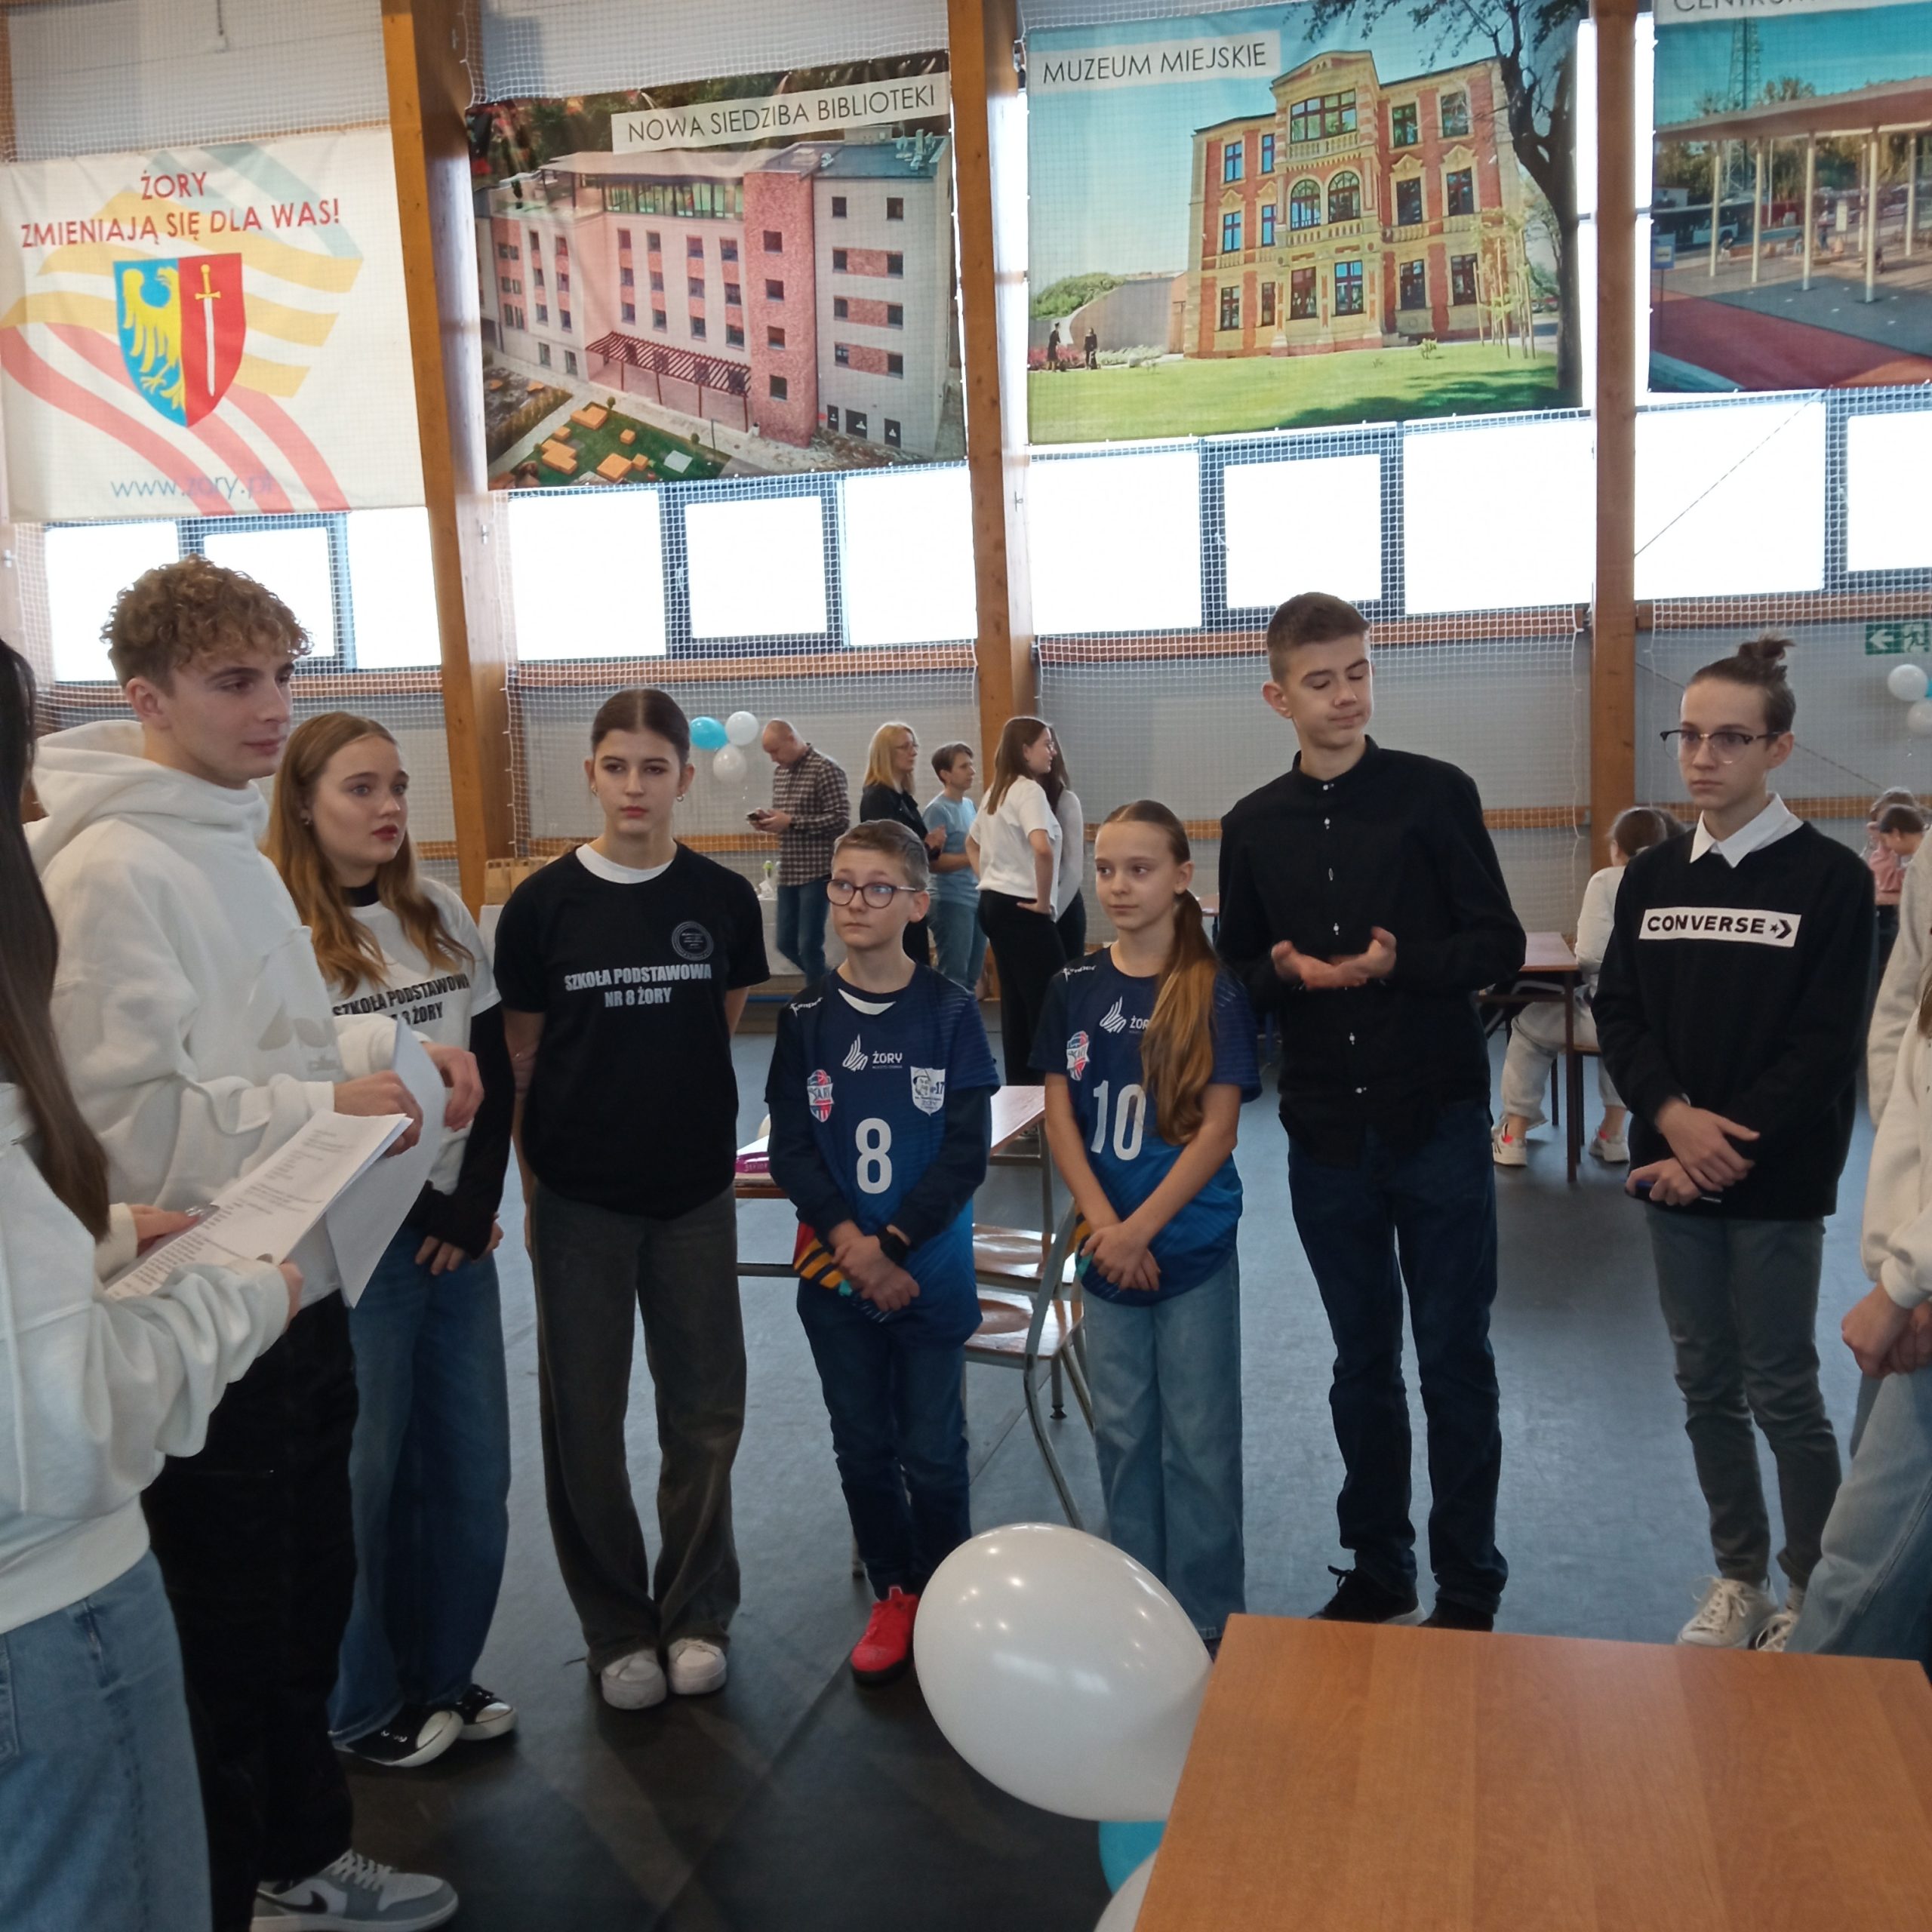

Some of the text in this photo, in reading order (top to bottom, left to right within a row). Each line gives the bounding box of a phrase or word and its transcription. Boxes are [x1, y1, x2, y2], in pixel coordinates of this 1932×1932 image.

[1044, 42, 1266, 84] MUZEUM MIEJSKIE
[629, 85, 935, 143] NOWA SIEDZIBA BIBLIOTEKI
[140, 170, 208, 201] ŻORY
[21, 198, 340, 248] ZMIENIAJĄ SIĘ DLA WAS!
[1647, 915, 1766, 934] CONVERSE
[564, 964, 712, 991] SZKOŁA PODSTAWOWA
[605, 986, 672, 1008] NR 8 ŻORY
[412, 1005, 442, 1024] ŻORY
[1129, 1015, 1150, 1029] ŻOR
[872, 1051, 903, 1063] ŻORY
[1091, 1080, 1146, 1161] 10
[856, 1118, 892, 1194] 8
